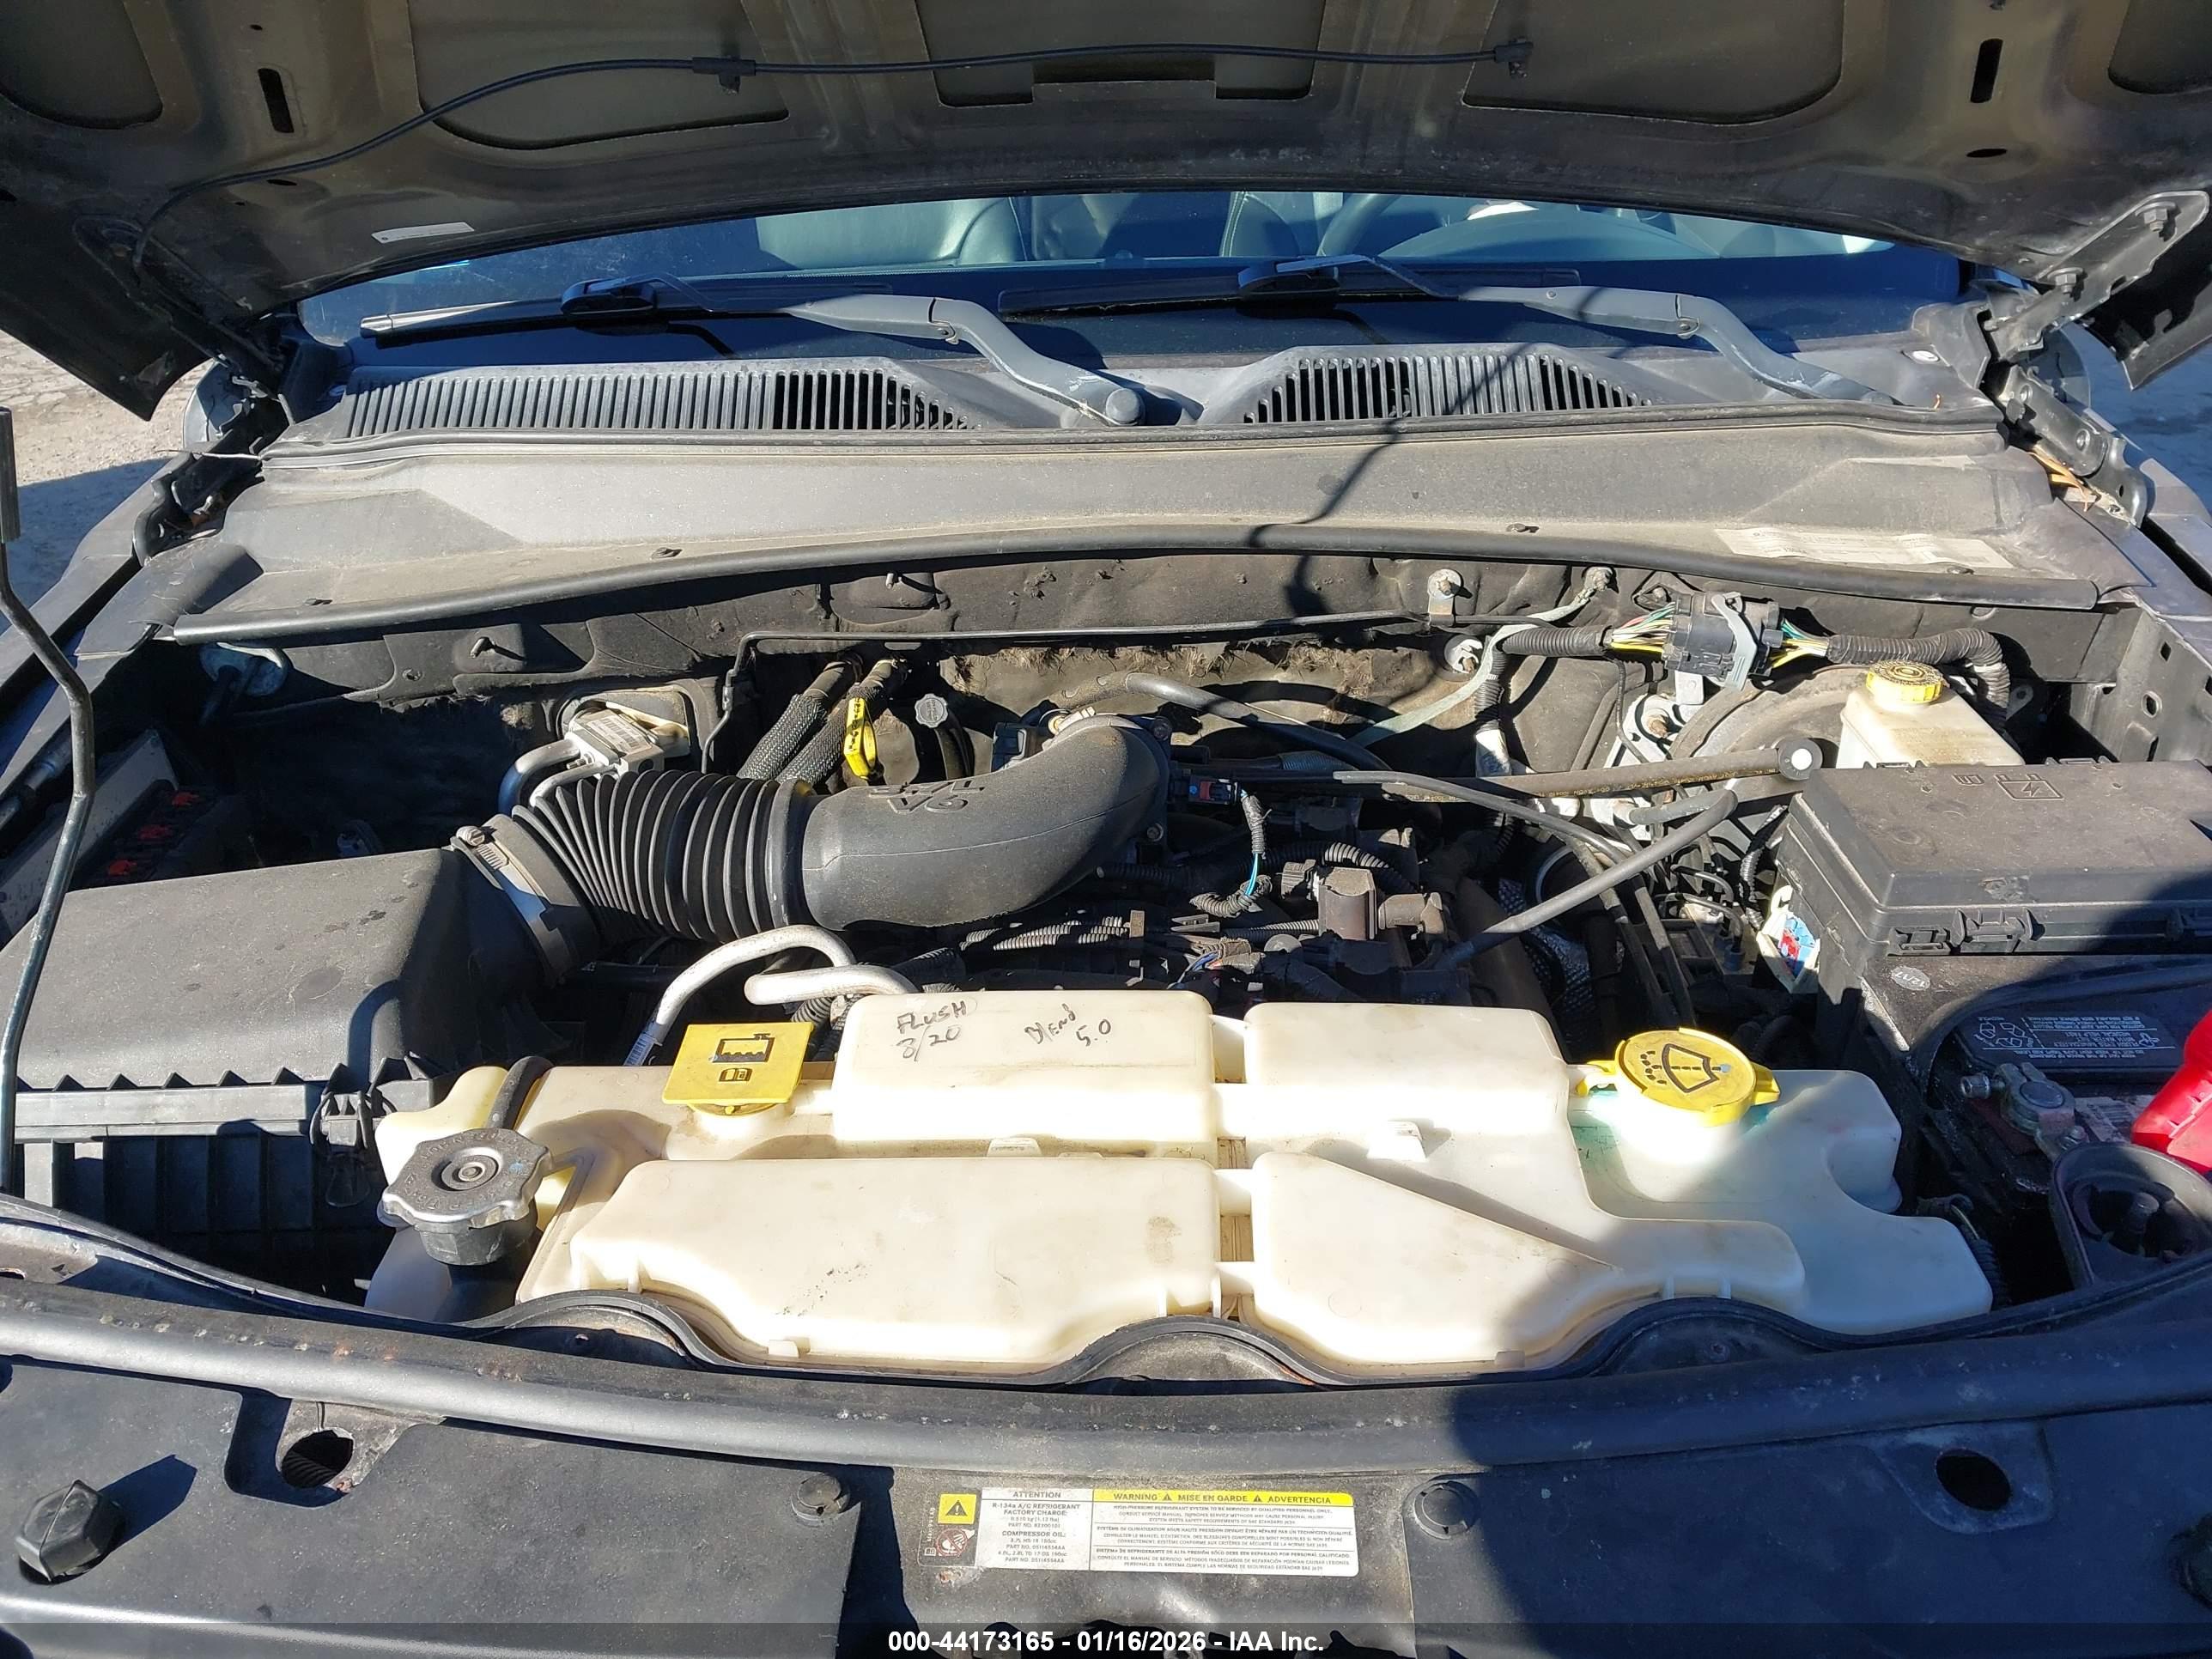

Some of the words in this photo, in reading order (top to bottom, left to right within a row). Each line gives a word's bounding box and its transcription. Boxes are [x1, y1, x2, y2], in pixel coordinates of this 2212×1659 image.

[1894, 971, 1928, 988] 12/17
[896, 1000, 967, 1034] FLUSH
[1076, 1018, 1111, 1047] 5.0
